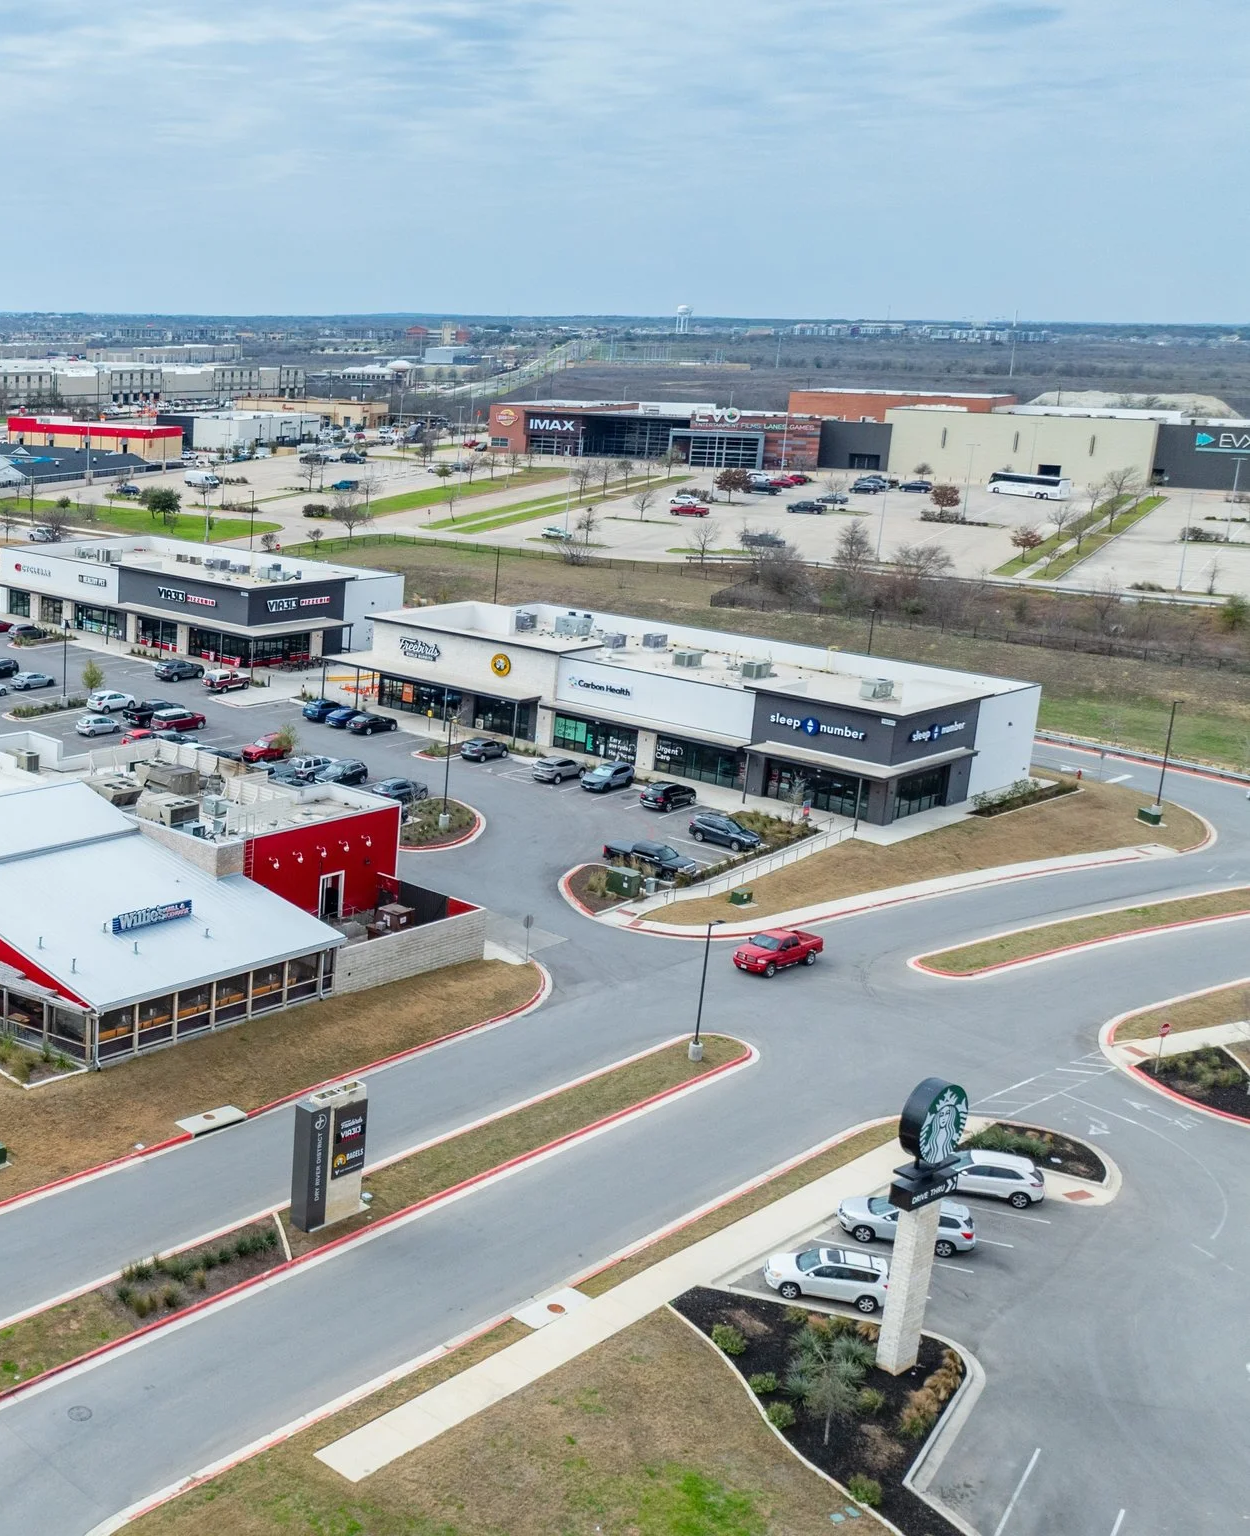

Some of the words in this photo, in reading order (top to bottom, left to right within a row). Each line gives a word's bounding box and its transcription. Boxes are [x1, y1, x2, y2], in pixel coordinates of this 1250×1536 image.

[695, 407, 741, 423] EVO
[530, 419, 575, 432] IMAX
[400, 637, 440, 657] Freebirds
[578, 679, 605, 691] Carbon
[606, 685, 630, 696] Health
[770, 713, 800, 730] sleep
[819, 724, 865, 740] number
[911, 728, 930, 742] sleep
[941, 720, 965, 735] number
[655, 751, 671, 762] Care
[656, 744, 679, 756] Urgent
[119, 905, 167, 930] Willie's
[346, 1147, 364, 1161] BAGELS
[912, 1191, 929, 1204] DRIVE
[930, 1184, 946, 1195] THRU
